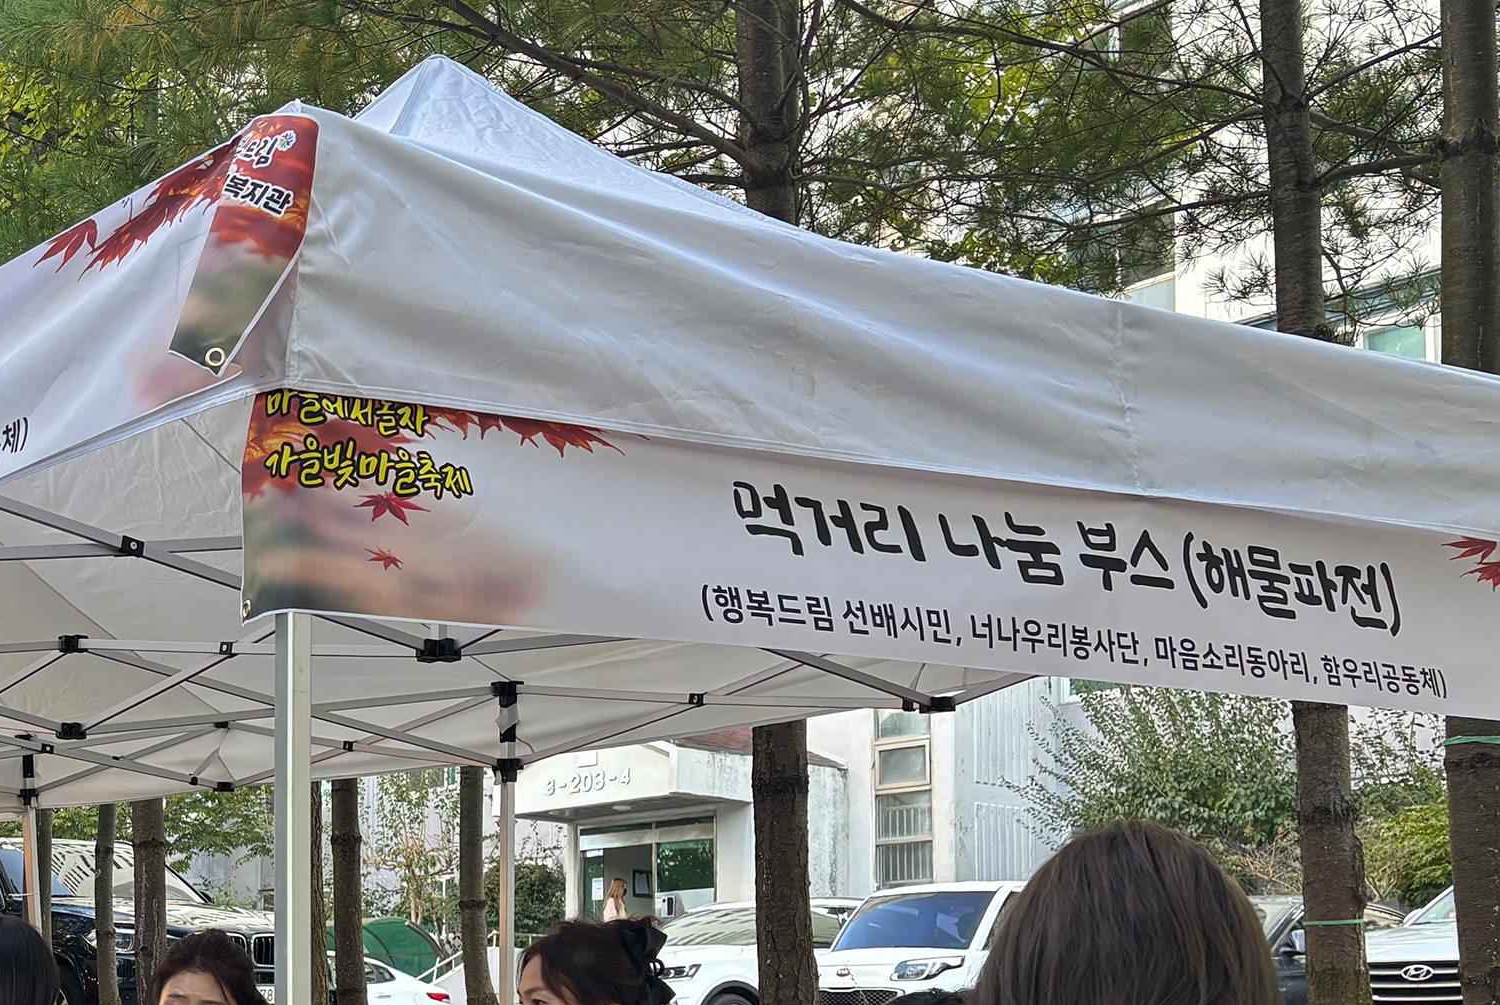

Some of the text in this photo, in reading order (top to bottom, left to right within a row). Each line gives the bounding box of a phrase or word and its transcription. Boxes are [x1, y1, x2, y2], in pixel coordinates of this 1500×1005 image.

[224, 174, 292, 215] 복지관
[731, 479, 927, 564] 먹거리
[938, 512, 1064, 587] 나눔
[701, 583, 1448, 700] (행복드림 선배시민, 너나우리봉사단, 마음소리동아리, 함우리공동체)
